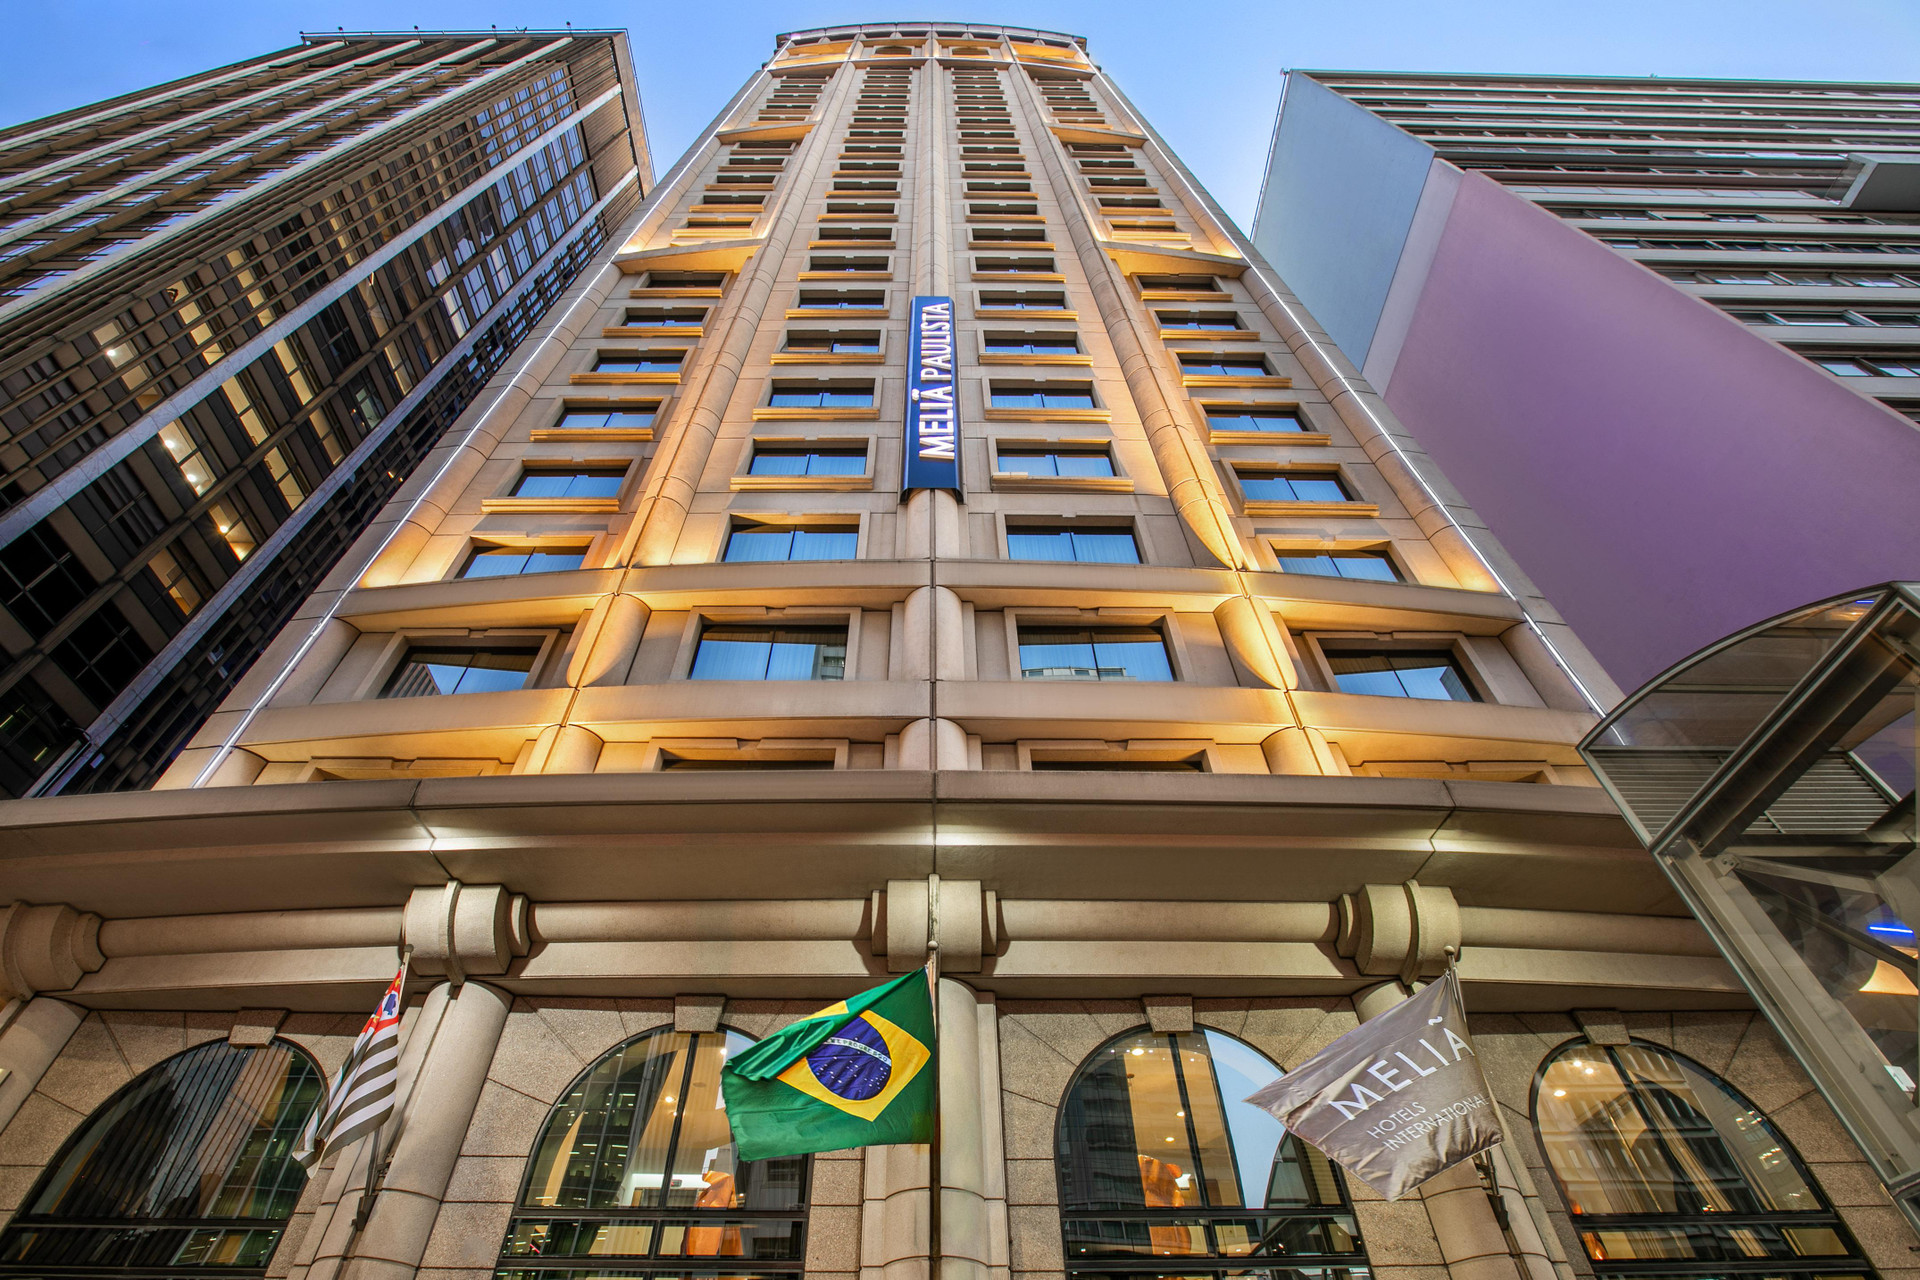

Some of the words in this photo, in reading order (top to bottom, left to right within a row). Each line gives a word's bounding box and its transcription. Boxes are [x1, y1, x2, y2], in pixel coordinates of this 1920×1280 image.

[920, 303, 952, 381] PAULISTA
[1367, 1101, 1427, 1139] HOTELS
[1382, 1094, 1489, 1151] INTERNATIONAL
